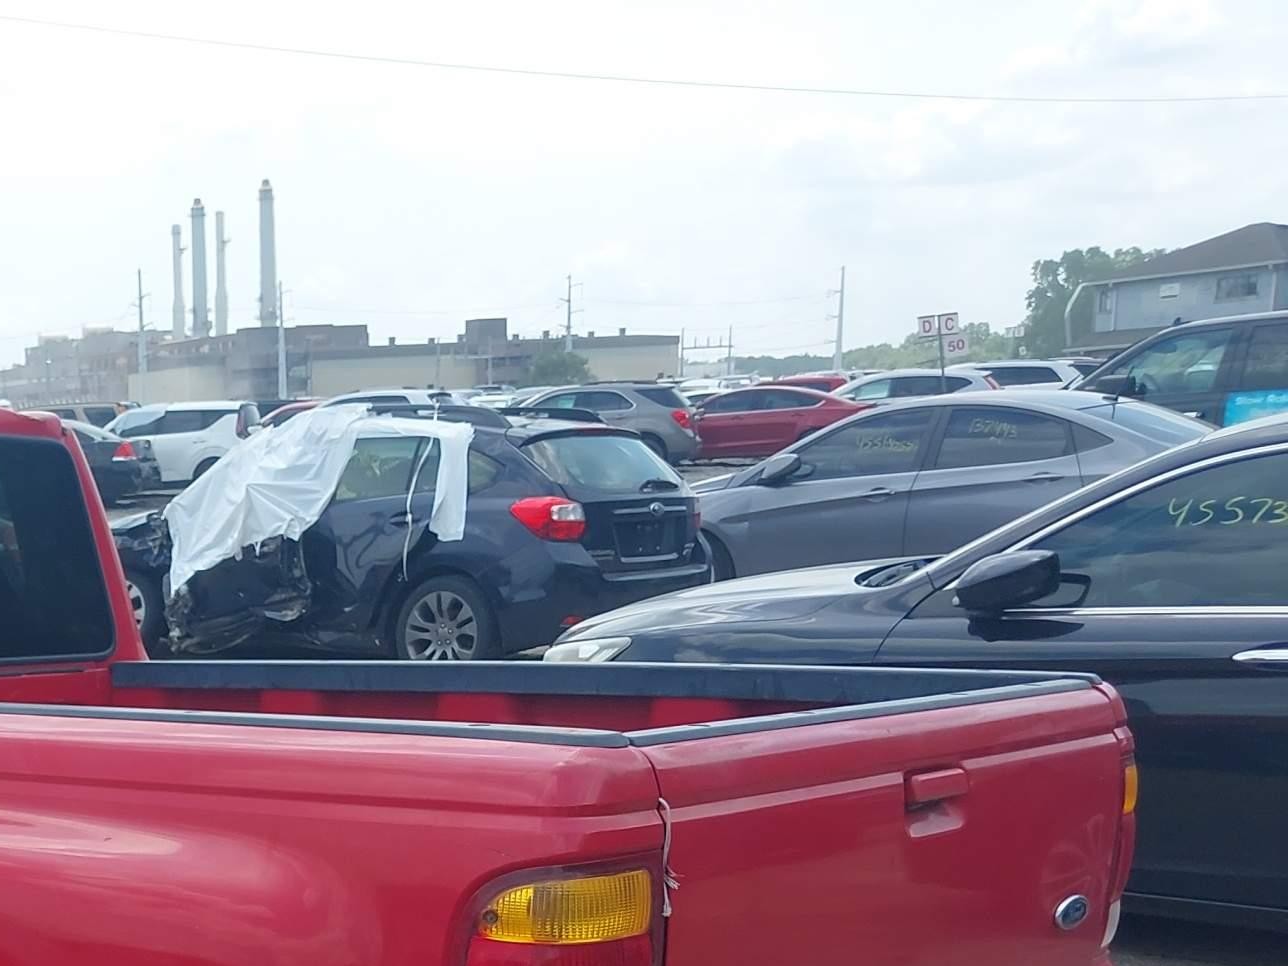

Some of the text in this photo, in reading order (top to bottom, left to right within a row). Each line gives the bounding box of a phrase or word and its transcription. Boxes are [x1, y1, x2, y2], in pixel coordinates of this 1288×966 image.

[922, 320, 932, 334] D
[945, 317, 955, 331] C
[947, 338, 966, 352] 50
[1168, 496, 1288, 528] 45573
